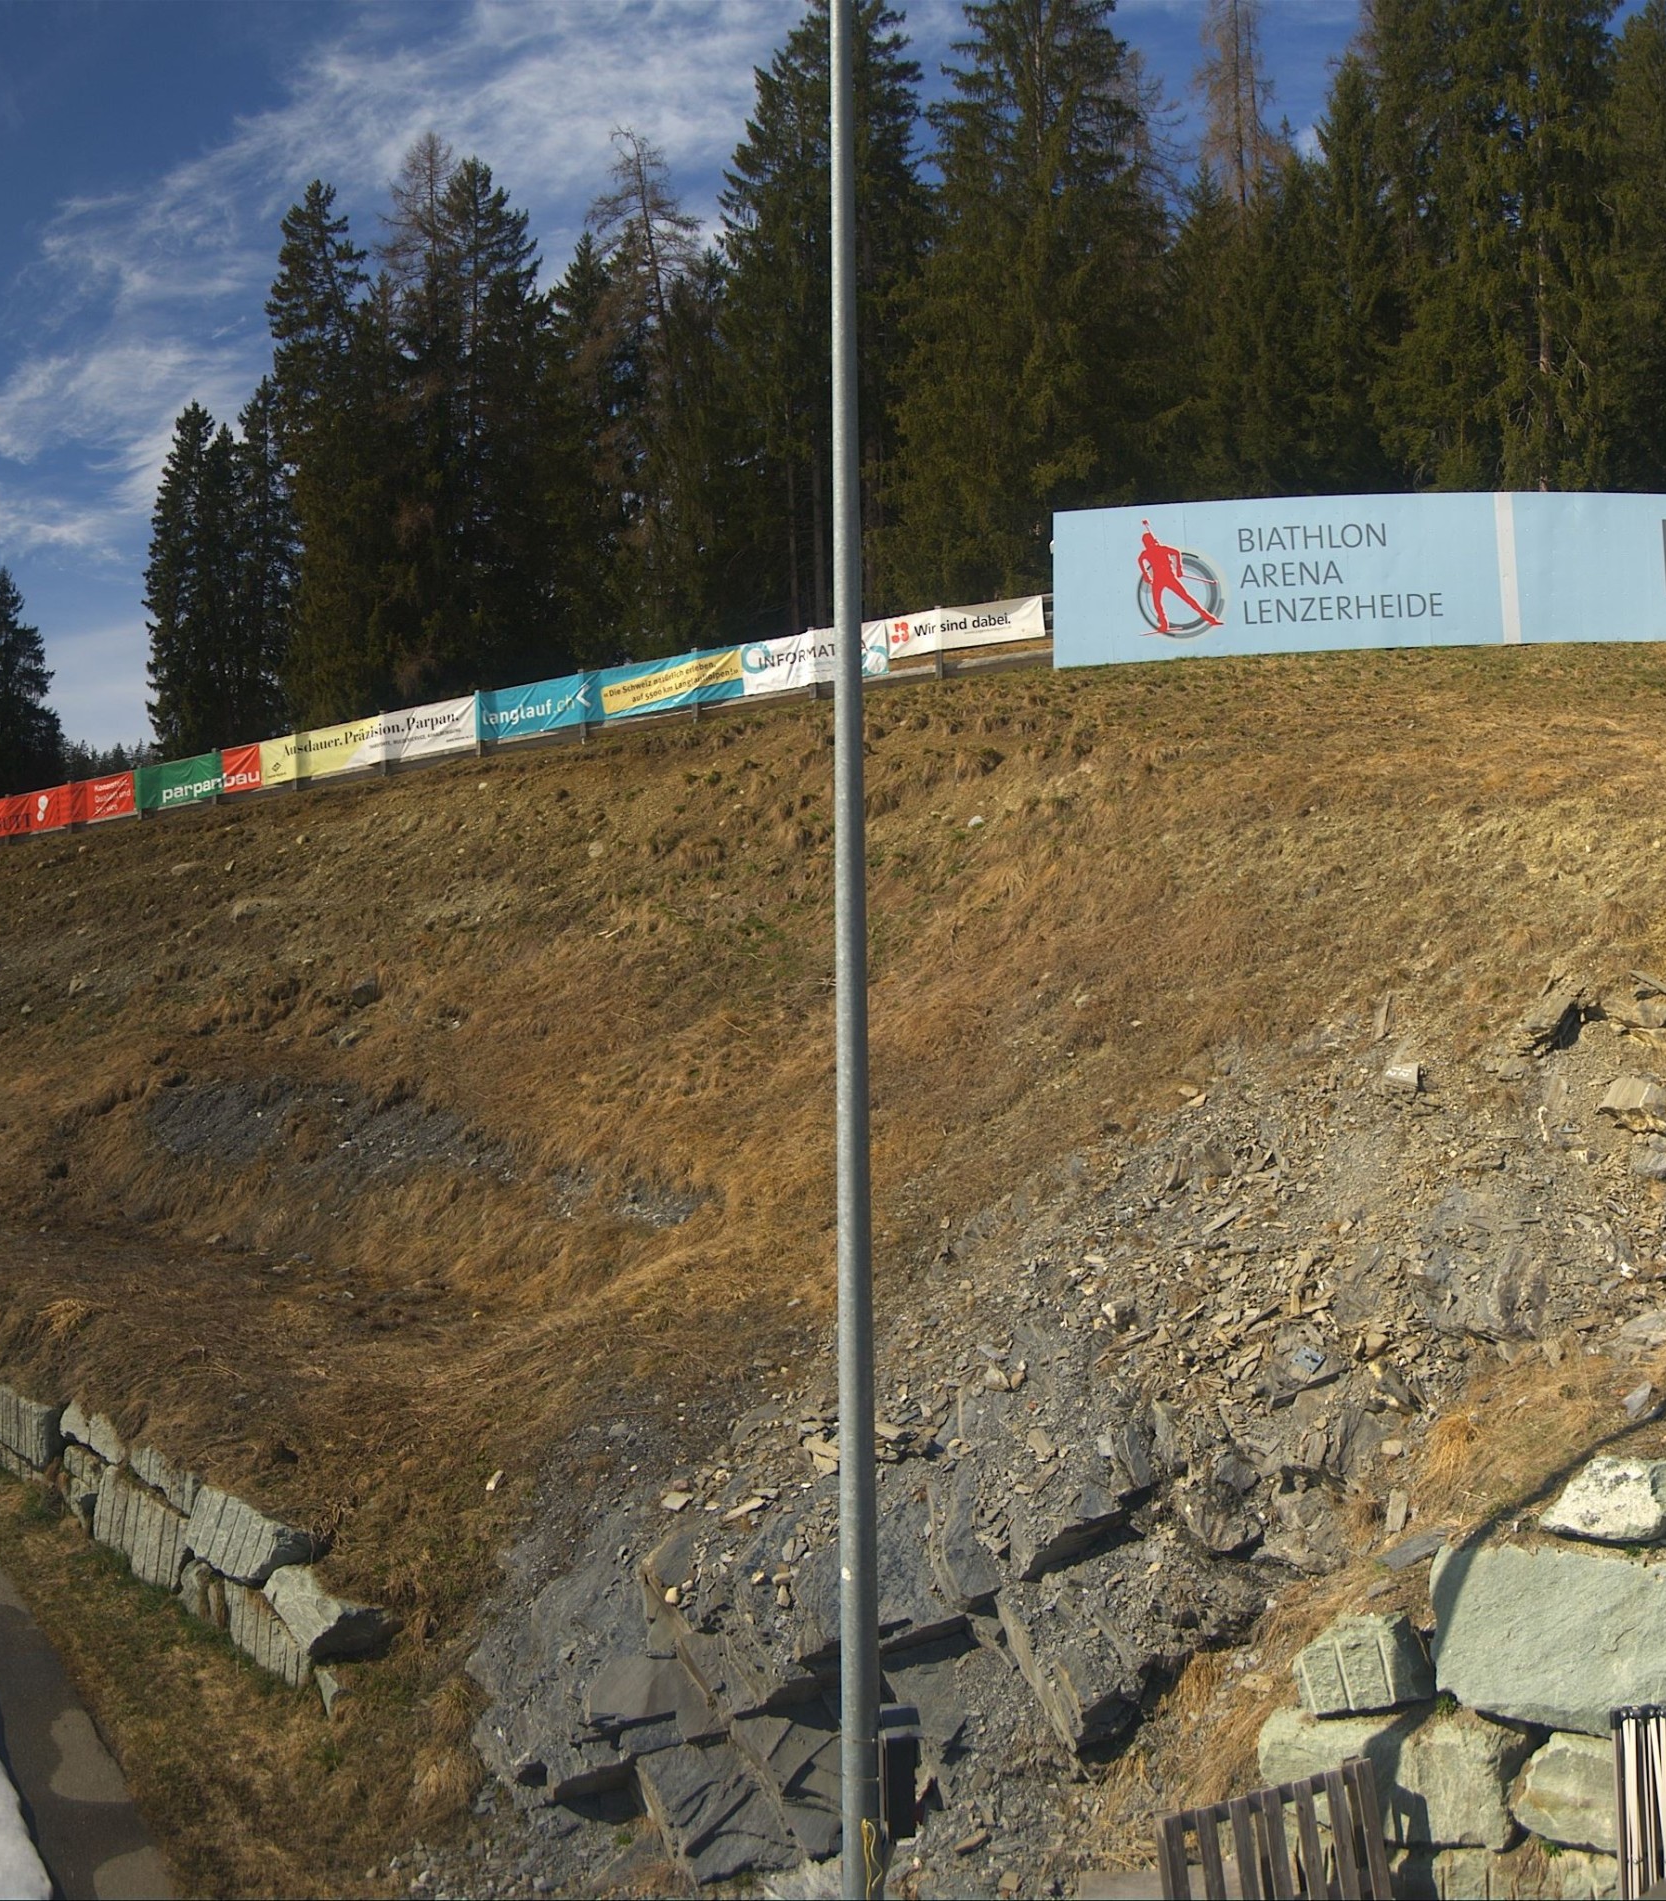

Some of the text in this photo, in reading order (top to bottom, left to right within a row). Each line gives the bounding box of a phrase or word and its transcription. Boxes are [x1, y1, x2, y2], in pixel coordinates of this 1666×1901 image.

[1238, 523, 1387, 554] BIATHLON
[1240, 560, 1344, 589] ARENA
[1243, 593, 1444, 625] LENZERHEIDE
[914, 623, 936, 637] Wir
[940, 618, 967, 632] sind
[972, 613, 1011, 629] dabei.
[758, 639, 869, 669] INFORMATA
[622, 679, 652, 695] Schweiz
[632, 693, 644, 703] auf
[645, 689, 662, 701] 5500
[663, 685, 674, 695] km
[482, 694, 575, 725] langlauf.ch
[283, 736, 343, 758] Ausdauer.
[344, 723, 404, 745] Präzision.
[406, 713, 459, 731] Parpan.
[162, 771, 261, 803] parpanbau
